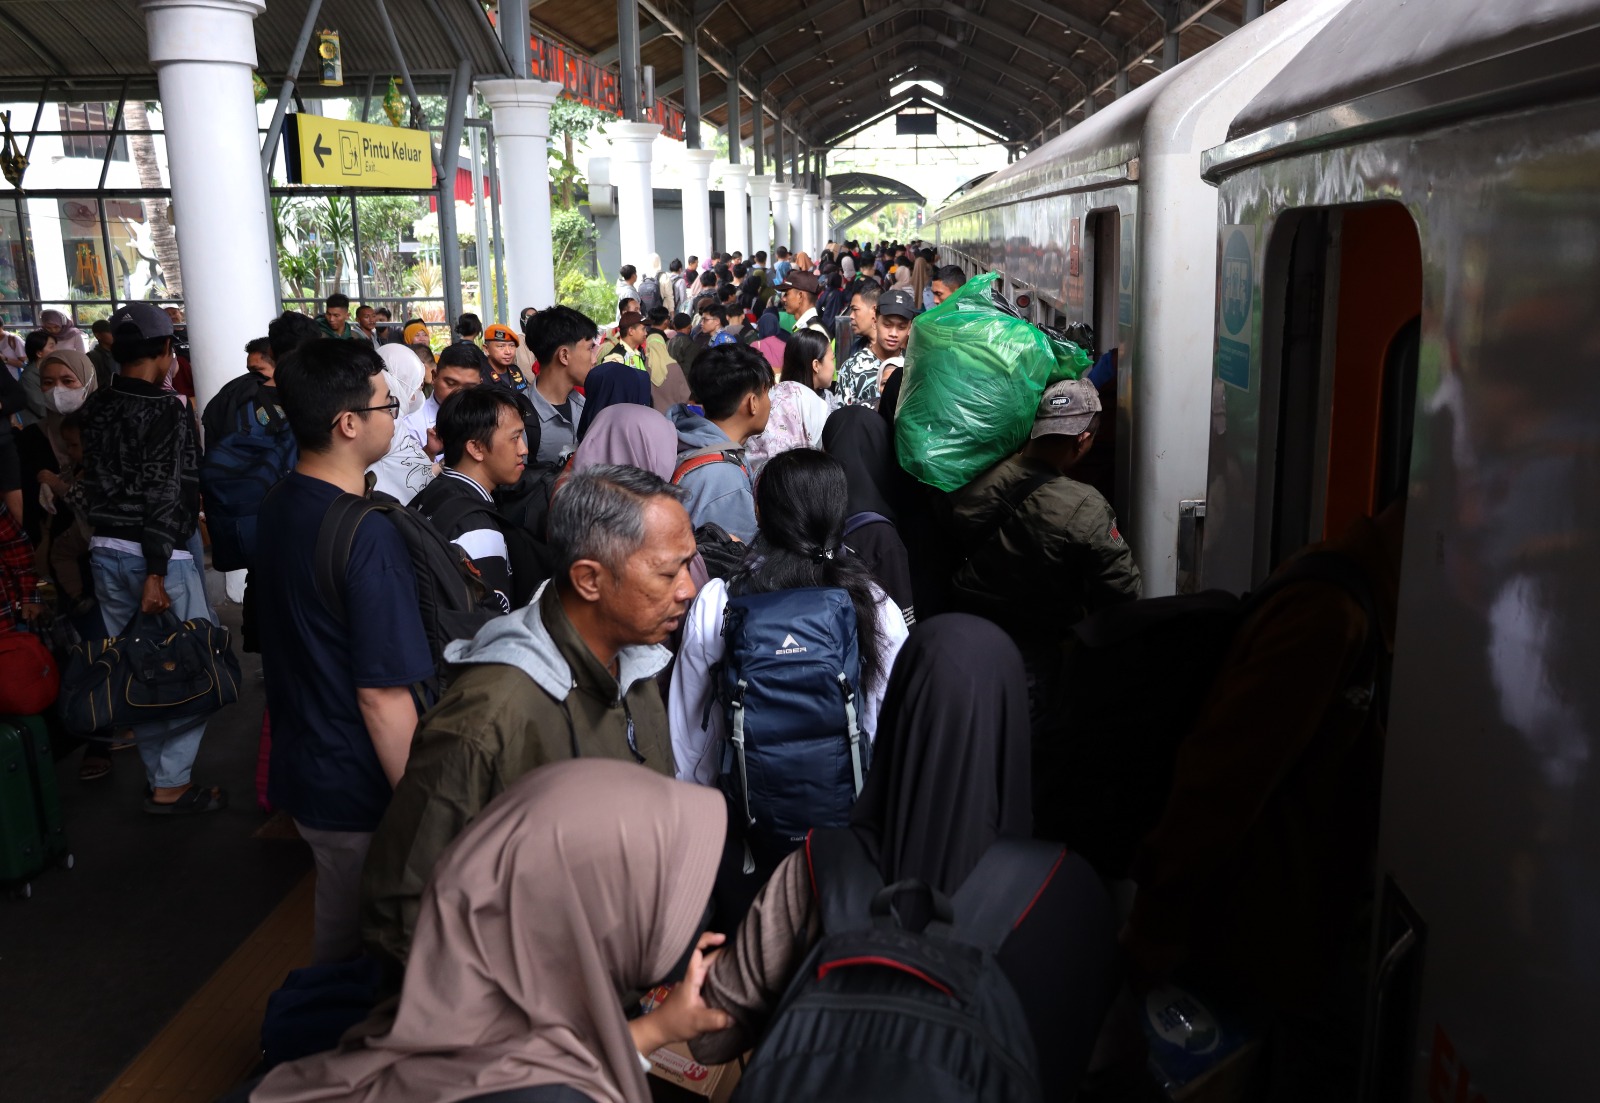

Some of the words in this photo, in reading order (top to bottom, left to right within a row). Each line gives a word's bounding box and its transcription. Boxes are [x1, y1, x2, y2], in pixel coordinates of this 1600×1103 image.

[362, 137, 389, 159] Pintu
[392, 140, 422, 162] Keluar
[365, 161, 376, 173] Exit
[775, 646, 807, 656] EIGER
